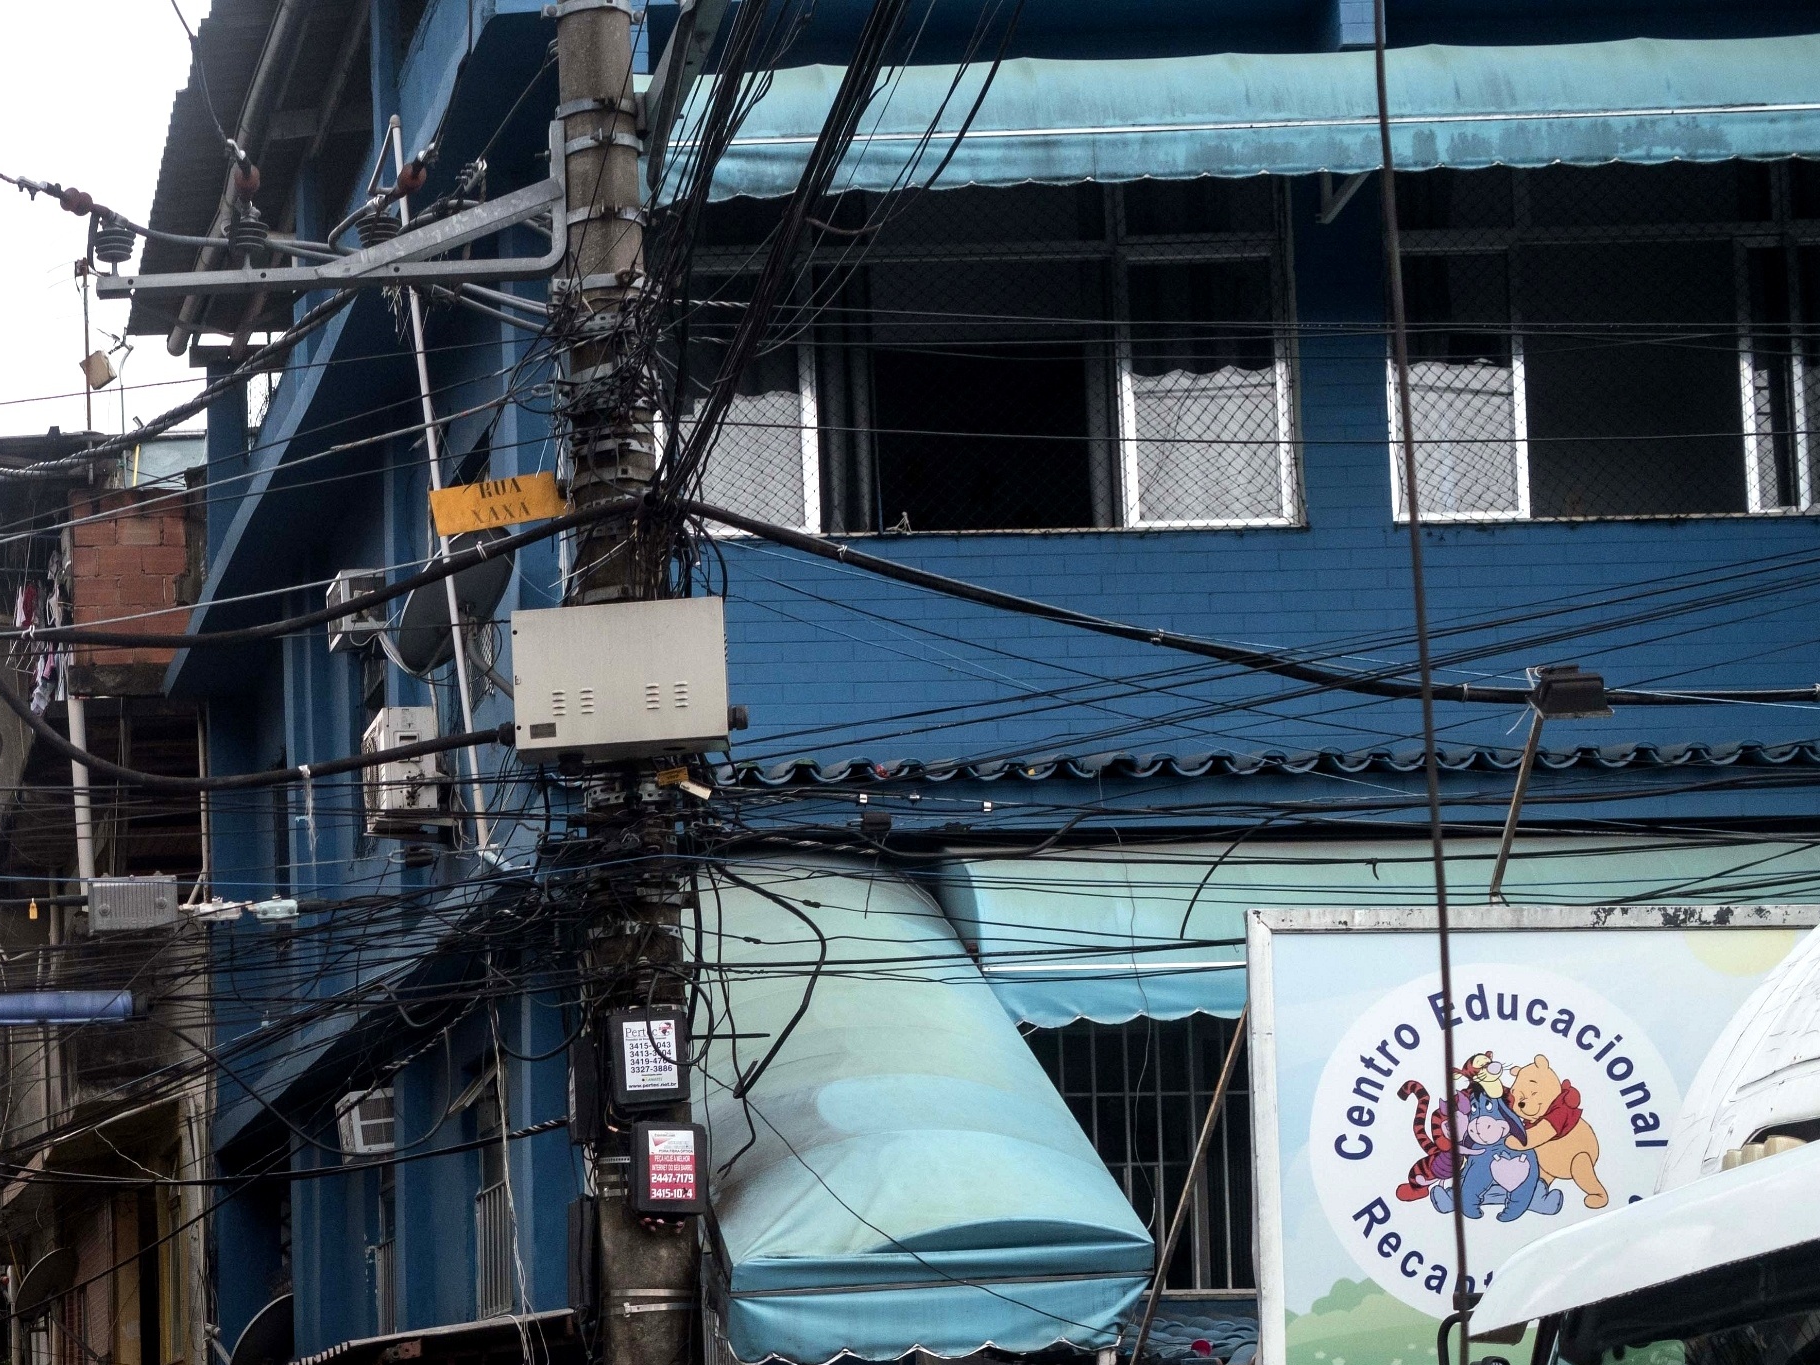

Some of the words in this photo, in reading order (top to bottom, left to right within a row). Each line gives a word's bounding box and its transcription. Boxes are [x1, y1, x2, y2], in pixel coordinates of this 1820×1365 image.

[480, 477, 522, 499] RUA
[625, 1027, 658, 1038] Pertc
[629, 1041, 671, 1050] 3415-043
[629, 1049, 672, 1058] 3413-304
[630, 1065, 673, 1073] 3327-3886
[1334, 1022, 1421, 1161] Centro
[1427, 983, 1669, 1148] Educacional
[651, 1173, 694, 1183] 2447-7179
